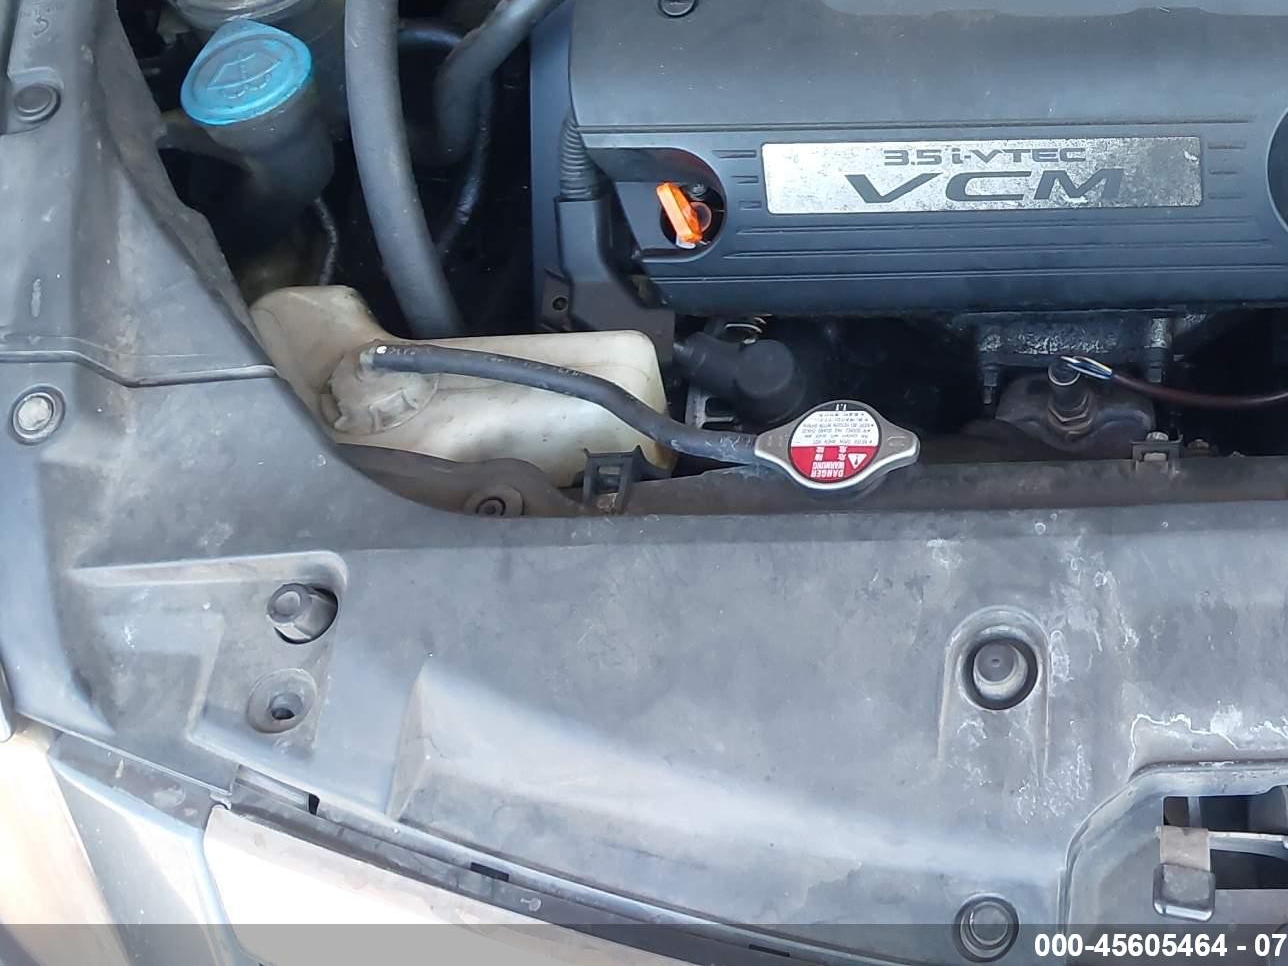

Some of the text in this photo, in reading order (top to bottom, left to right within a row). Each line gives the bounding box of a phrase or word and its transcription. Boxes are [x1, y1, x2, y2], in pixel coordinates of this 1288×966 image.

[884, 148, 1087, 166] 3.5 i-VTEC
[844, 168, 1126, 204] VCM
[812, 461, 845, 469] WARNING
[811, 469, 845, 478] DANGER
